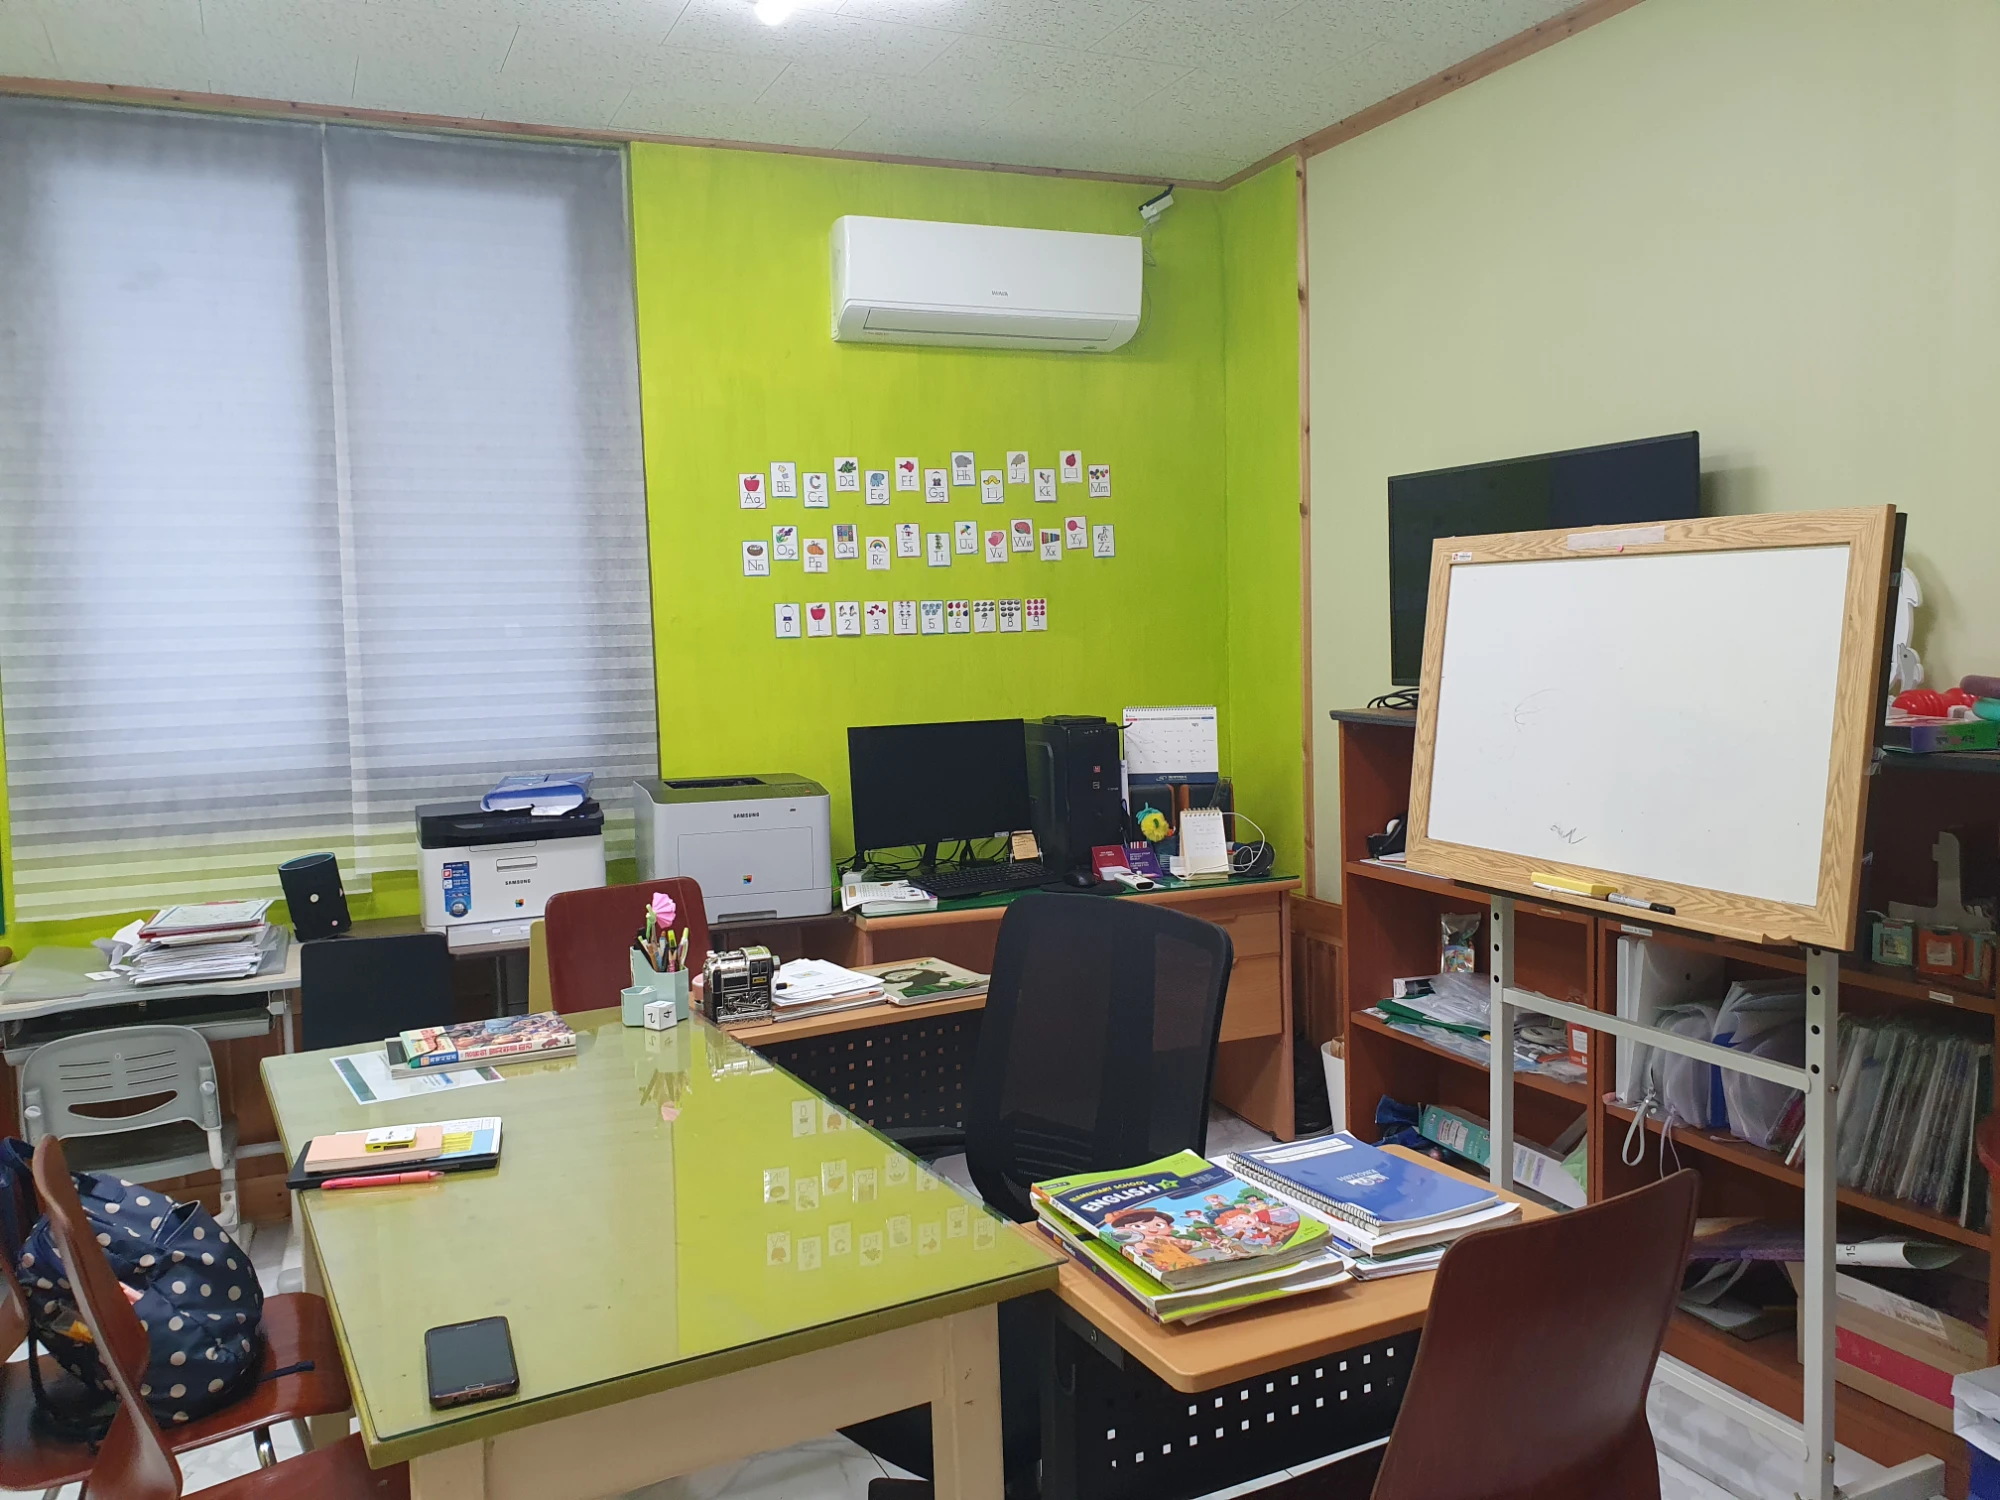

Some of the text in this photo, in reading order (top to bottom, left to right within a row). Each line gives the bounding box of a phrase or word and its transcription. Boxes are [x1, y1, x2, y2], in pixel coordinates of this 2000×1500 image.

[956, 470, 971, 481] Hh
[839, 475, 855, 487] Dd
[901, 476, 913, 486] Ff
[777, 481, 791, 492] Bb
[1040, 486, 1051, 496] Kk
[1091, 483, 1108, 493] Mm
[744, 493, 761, 504] Aa
[807, 492, 824, 503] Cc
[870, 489, 884, 500] Ee
[928, 488, 945, 501] Gg
[959, 539, 974, 550] Uu
[1013, 537, 1032, 547] Ww
[1071, 534, 1082, 545] Yy
[837, 543, 855, 557] Qq
[903, 542, 914, 553] Ss
[1045, 546, 1056, 556] Xx
[1098, 542, 1110, 552] Zz
[990, 548, 1002, 558] Vv
[808, 557, 822, 571] Pp
[872, 555, 883, 565] Rr
[748, 560, 764, 571] Nn
[816, 621, 822, 631] 1
[845, 620, 852, 630] 2
[873, 620, 880, 630] 3
[901, 619, 908, 629] 4
[928, 618, 935, 629] 5
[955, 618, 961, 628] 6
[982, 618, 988, 628] 7
[1007, 617, 1013, 627] 8
[1033, 616, 1040, 626] 9
[784, 622, 791, 632] 0
[1081, 1184, 1160, 1212] ENGLISH
[1846, 1245, 1856, 1257] 15
